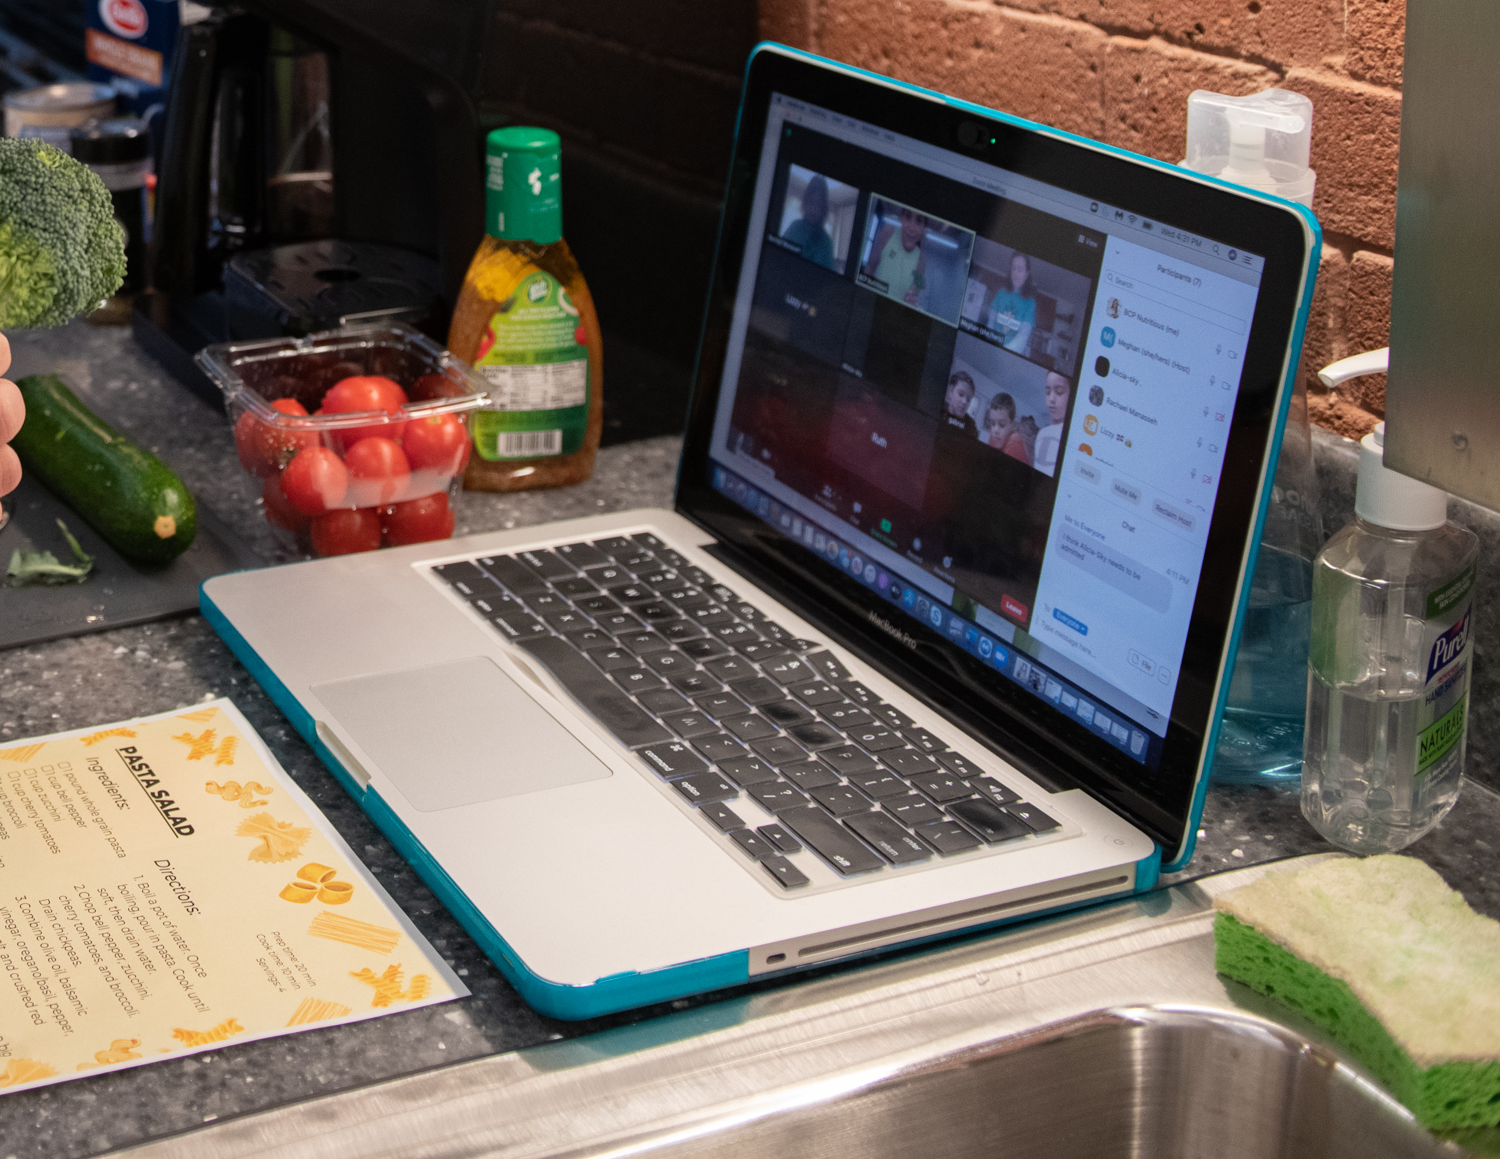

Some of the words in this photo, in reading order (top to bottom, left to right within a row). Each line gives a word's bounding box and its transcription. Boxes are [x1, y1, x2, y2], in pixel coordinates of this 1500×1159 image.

[1161, 228, 1175, 239] Wed
[1191, 237, 1202, 247] PM
[1115, 276, 1133, 289] Search
[1157, 264, 1192, 284] Participants
[1192, 277, 1202, 288] (7)
[960, 319, 979, 333] Meghan
[979, 324, 1004, 343] (she/hers)
[1123, 308, 1137, 319] BCP
[1136, 312, 1165, 332] Nutritious
[1165, 325, 1180, 337] (me)
[1118, 338, 1141, 353] Meghan
[1141, 344, 1171, 366] (she/hers)
[1171, 358, 1191, 375] (Host)
[1106, 396, 1128, 413] Rachael
[871, 432, 887, 448] Ruth
[1100, 426, 1115, 439] Lizzy
[1080, 467, 1095, 479] Invite
[1114, 484, 1128, 496] Mute
[1128, 489, 1138, 500] Me
[1065, 514, 1073, 524] Me
[1080, 522, 1106, 541] Everyone
[1121, 520, 1136, 534] Chat
[1178, 514, 1192, 528] Host
[1060, 543, 1085, 561] admitted
[1065, 534, 1079, 547] think
[1079, 542, 1108, 563] Alicia-Sky
[1108, 558, 1125, 572] needs
[1125, 567, 1132, 576] to
[1132, 571, 1141, 581] be
[1178, 574, 1190, 585] PM
[1005, 601, 1023, 616] Leave
[868, 610, 902, 640] MacBook
[902, 632, 917, 650] Pro
[1056, 611, 1080, 630] Everyone
[1041, 620, 1054, 634] Type
[1054, 629, 1079, 648] message
[1141, 660, 1152, 671] File
[1425, 685, 1443, 707] HAND
[1420, 705, 1464, 757] NATURALS
[644, 749, 675, 772] command
[84, 755, 131, 811] Ingredients:
[117, 744, 161, 789] PASTA
[148, 788, 195, 837] SALAD
[681, 781, 701, 797] option
[877, 839, 900, 857] return
[902, 835, 923, 852] enter
[833, 853, 851, 868] shift
[135, 881, 157, 899] Boil
[152, 858, 202, 916] Directions:
[56, 894, 80, 922] cherry
[115, 882, 141, 915] boiling,
[146, 898, 158, 906] a
[89, 913, 110, 931] bell
[131, 913, 155, 934] pour
[148, 904, 169, 921] pot
[36, 897, 58, 922] Drain
[50, 921, 83, 968] chickpeas.
[95, 886, 115, 906] soft,
[106, 904, 127, 927] then
[119, 925, 141, 949] drain
[133, 947, 158, 975] water.
[160, 919, 178, 929] of
[72, 920, 104, 966] tomatoes,
[97, 930, 127, 965] pepper,
[147, 933, 161, 944] in
[167, 927, 191, 955] water.
[38, 941, 58, 963] olive
[151, 942, 177, 969] pasta.
[49, 962, 68, 978] oil,
[96, 964, 119, 983] and
[185, 953, 208, 978] Once
[14, 939, 58, 1003] oregano/basil,
[44, 1001, 74, 1037] pepper,
[119, 962, 149, 1001] zucchini,
[170, 967, 195, 992] Cook
[8, 971, 39, 1009] crushed
[27, 1008, 47, 1026] red
[57, 975, 88, 1017] balsamic
[107, 981, 139, 1018] broccoli.
[185, 991, 211, 1013] until
